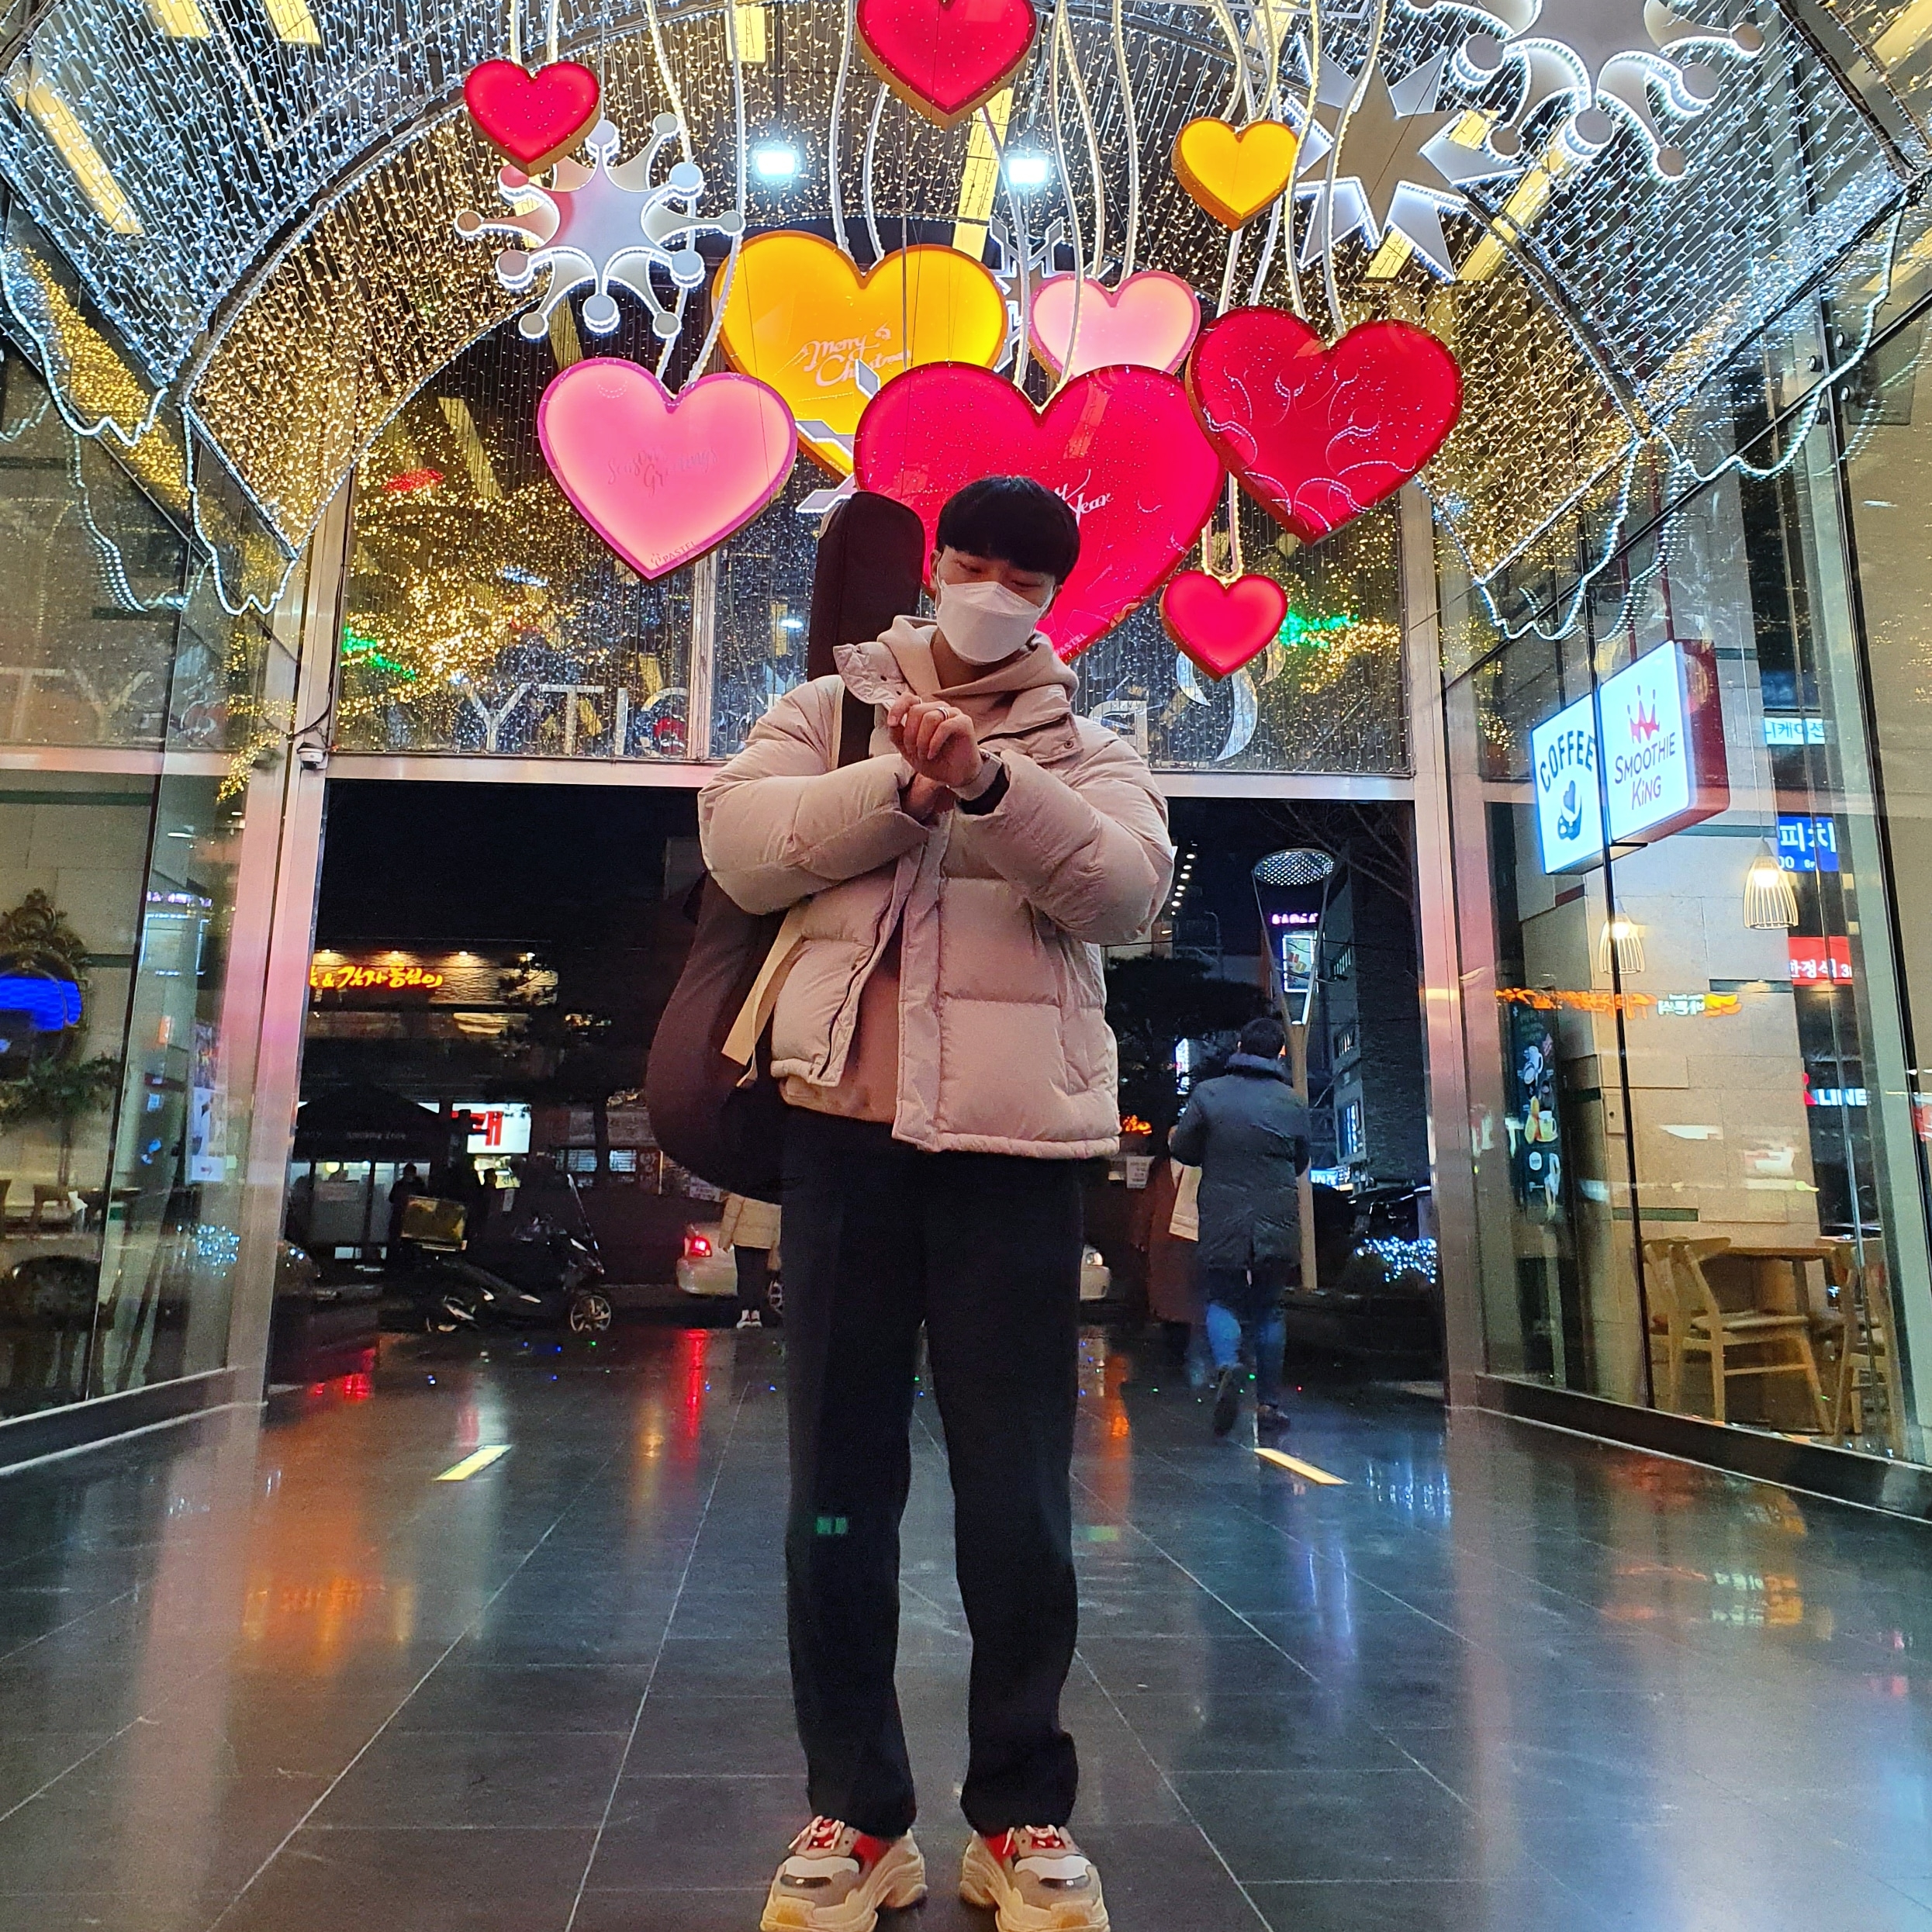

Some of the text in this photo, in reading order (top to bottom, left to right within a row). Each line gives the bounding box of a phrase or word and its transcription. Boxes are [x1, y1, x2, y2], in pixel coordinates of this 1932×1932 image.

[803, 334, 880, 372] Merry
[1067, 492, 1114, 527] Year
[662, 541, 697, 563] PASTEL
[1540, 730, 1595, 793] COFFEE
[1614, 731, 1675, 785] SMOOTHIE
[1779, 822, 1837, 853] 피치
[322, 973, 334, 987] &
